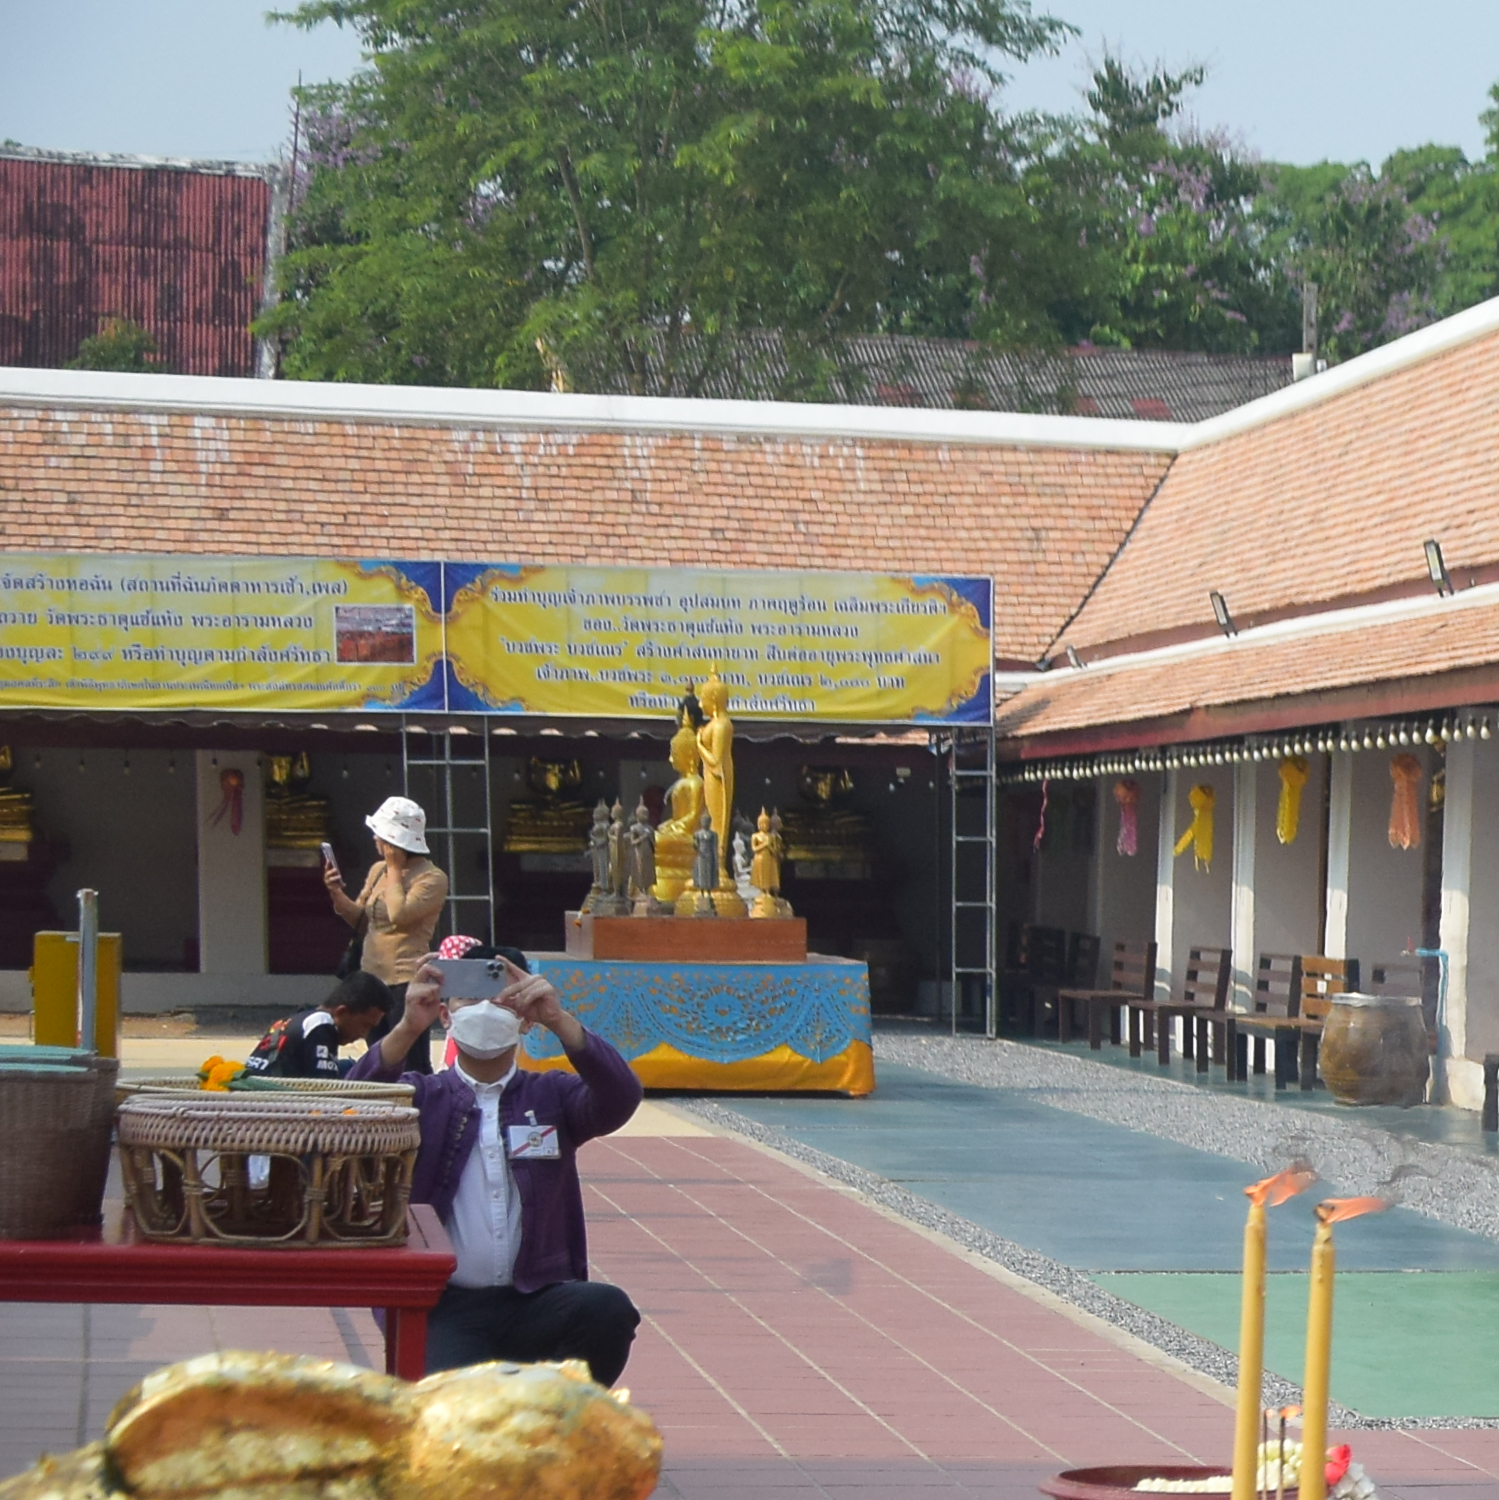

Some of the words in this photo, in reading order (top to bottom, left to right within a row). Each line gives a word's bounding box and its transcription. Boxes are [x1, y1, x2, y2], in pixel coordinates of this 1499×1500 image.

[490, 586, 671, 609] ร่วมทำบุญเจ้าภาพบรรพชา
[679, 592, 741, 613] อุปสมบท
[749, 595, 826, 615] ภาคฤดูร้อน
[47, 607, 183, 632] วัดพระธาตุแช่แห้ง
[192, 613, 313, 629] พระอารามหลวง
[751, 621, 859, 637] พระอารามหลวง
[123, 643, 330, 667] หรือทำบุญตามกำลังศรัทธา
[766, 643, 940, 668] สืบต่ออายุพระพุทธศาสนา
[877, 675, 905, 690] บาท
